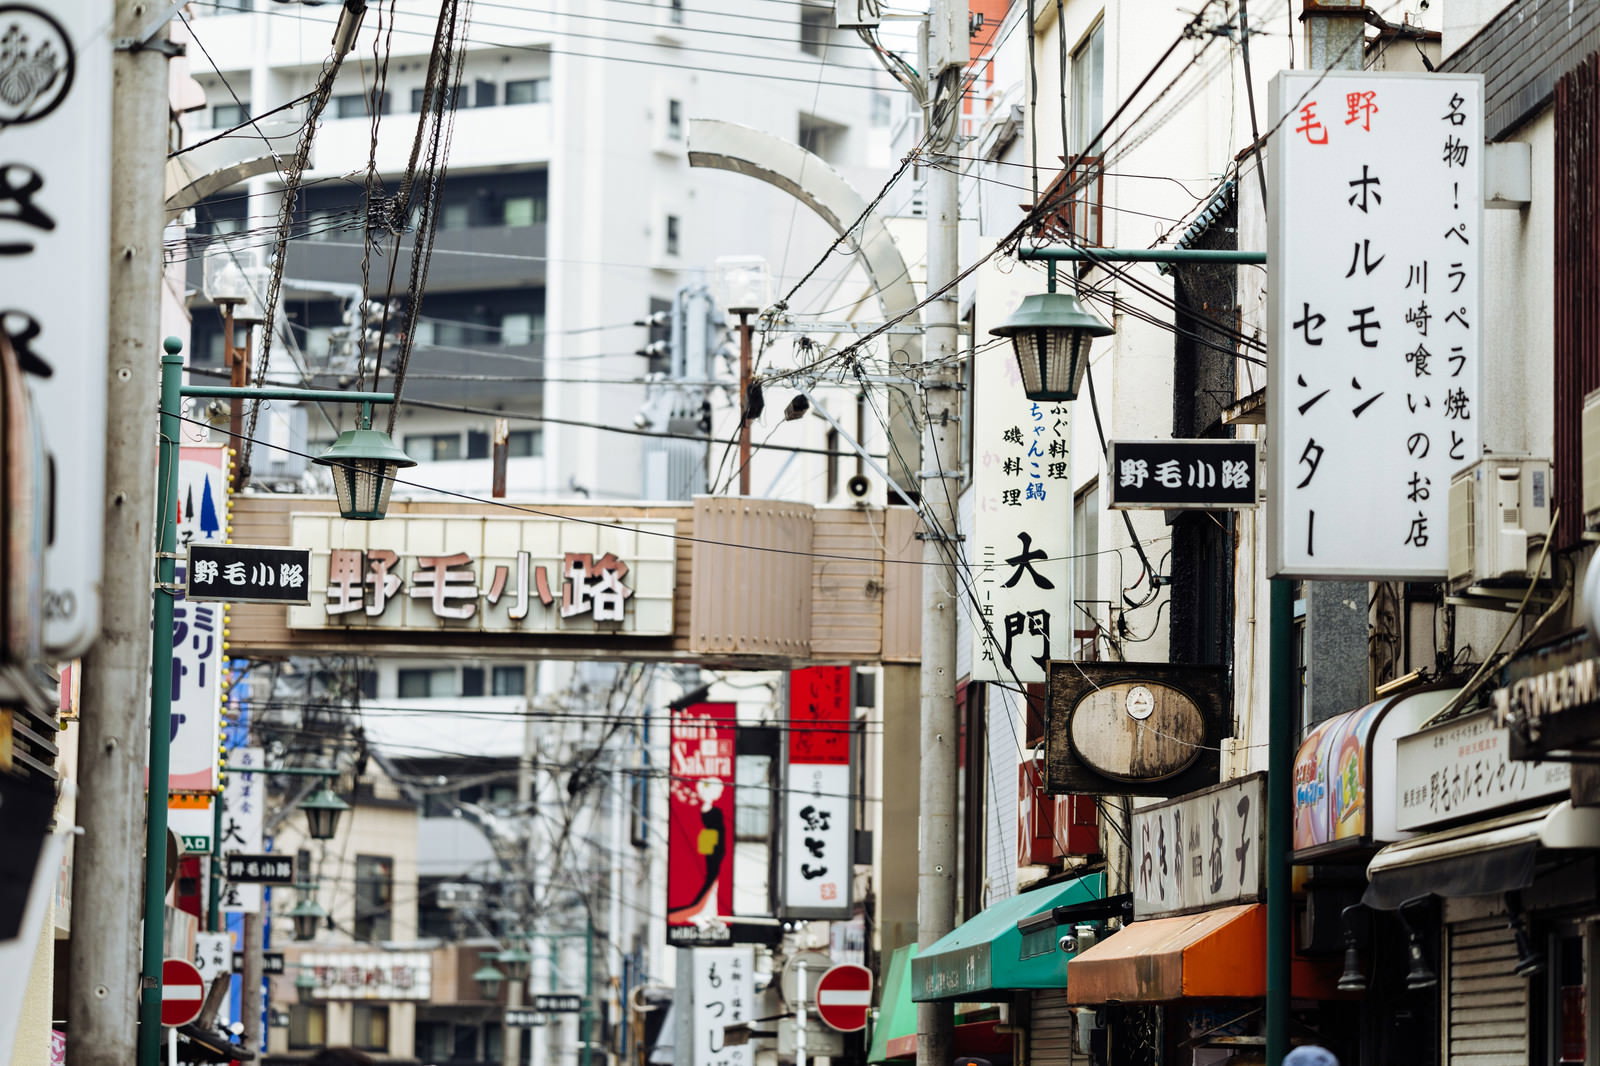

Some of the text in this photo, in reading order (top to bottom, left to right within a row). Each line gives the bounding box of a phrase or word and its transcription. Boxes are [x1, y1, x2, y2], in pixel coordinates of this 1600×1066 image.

[1345, 165, 1385, 418] ホルモン
[1441, 93, 1470, 460] 名物!ペラペラ焼と
[1025, 402, 1047, 502] ちゃんこ鍋
[1293, 302, 1331, 557] センター
[1404, 260, 1432, 547] 川崎喰いのお店
[1002, 425, 1024, 507] 磯料理
[1120, 458, 1250, 489] 野毛小路
[194, 560, 304, 588] 野毛小路
[325, 549, 634, 622] 野毛小路
[1000, 531, 1055, 672] 大門
[705, 961, 730, 1066] もつし
